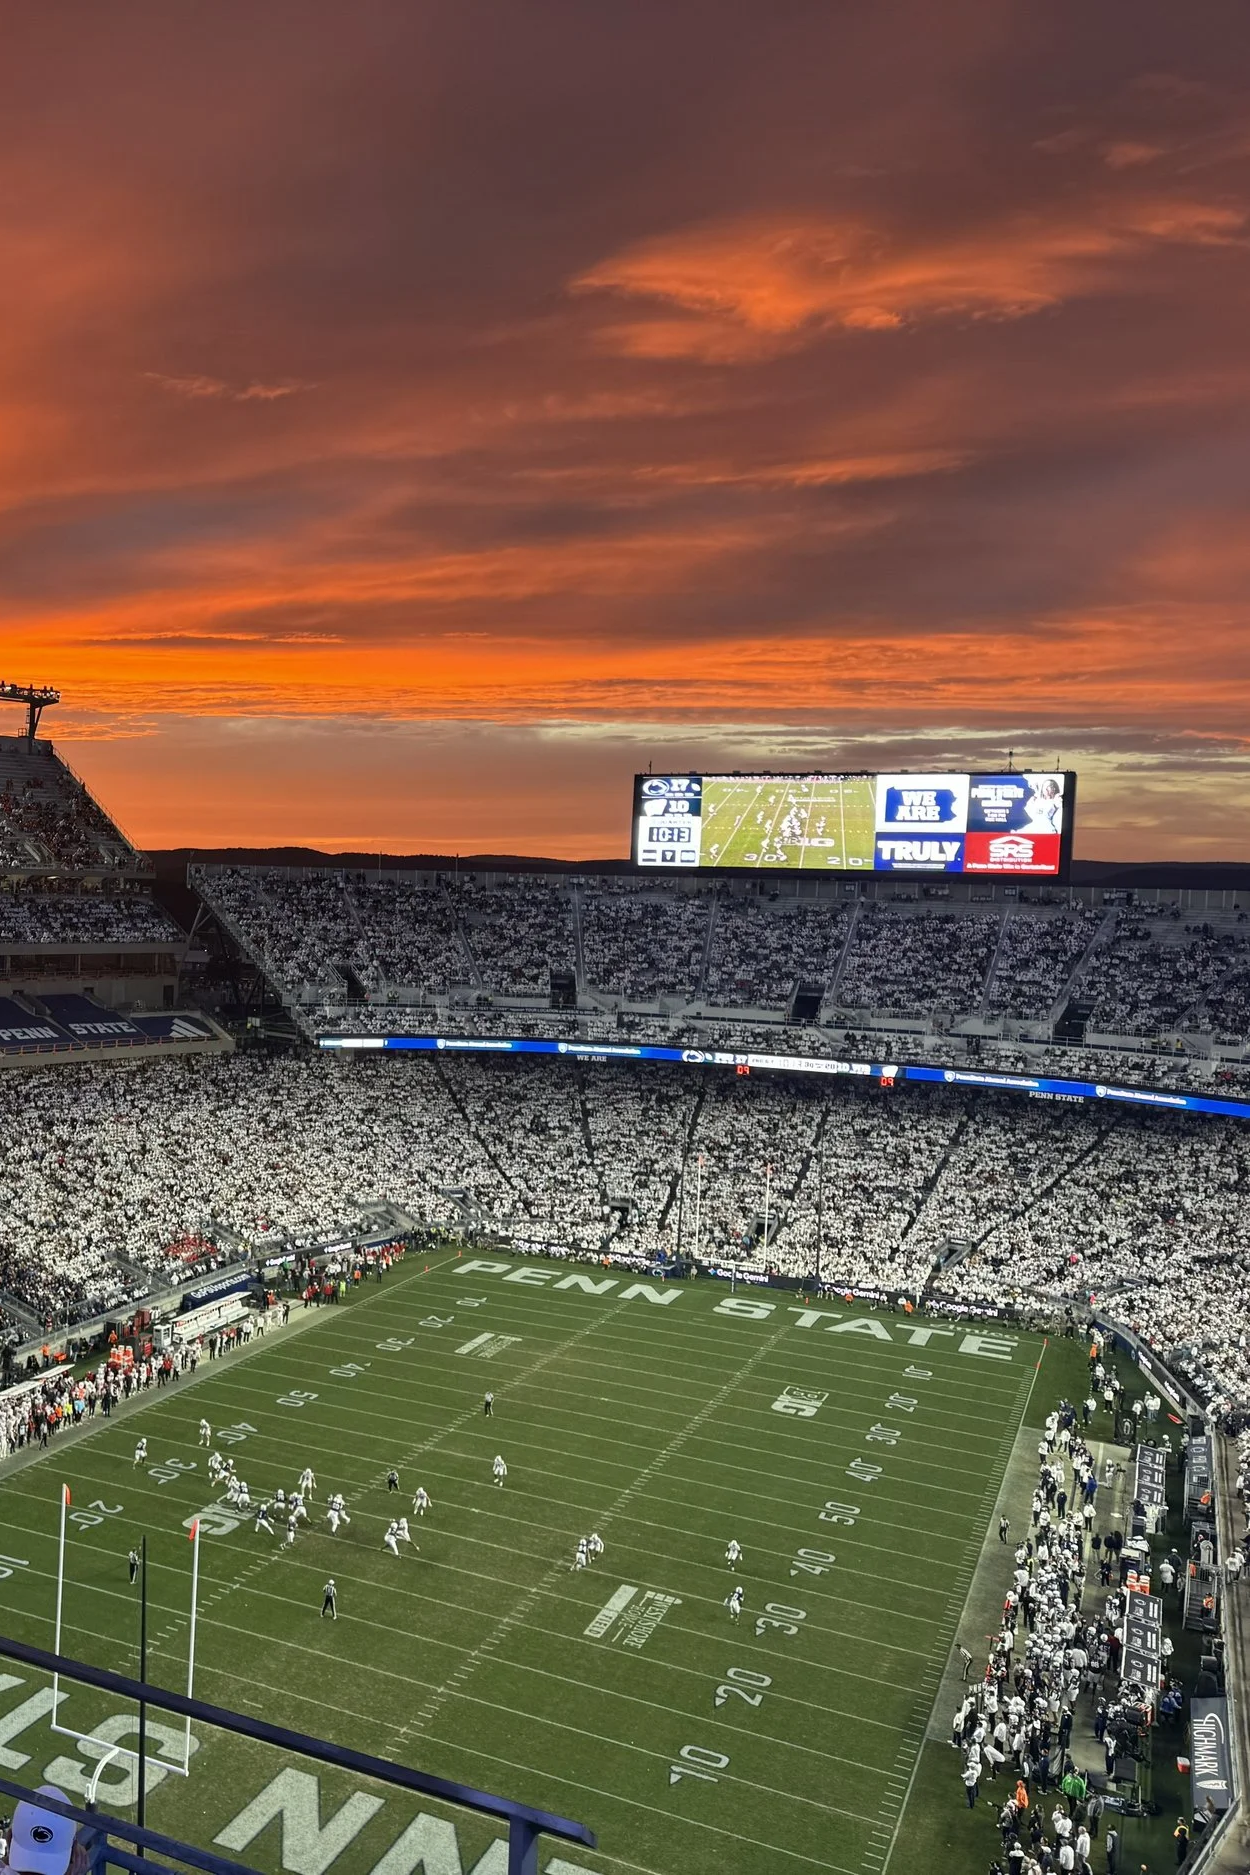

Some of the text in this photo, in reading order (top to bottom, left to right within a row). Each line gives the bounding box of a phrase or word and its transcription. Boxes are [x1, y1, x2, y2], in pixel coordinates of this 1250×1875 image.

[668, 800, 690, 813] 10
[901, 791, 936, 806] WE
[895, 806, 940, 821] ARE
[652, 828, 690, 842] 10:13
[989, 843, 1034, 857] SRS
[67, 1020, 137, 1035] STATE
[1028, 1091, 1085, 1103] PENN STATE
[452, 1259, 1019, 1361] PENN STATE
[418, 1315, 452, 1328] 20
[375, 1337, 412, 1351] 30
[329, 1362, 365, 1378] 40
[276, 1390, 319, 1407] 50
[884, 1395, 918, 1413] 20
[216, 1422, 258, 1441] 40
[865, 1426, 902, 1445] 30
[147, 1458, 198, 1480] 30
[846, 1461, 883, 1483] 40
[68, 1500, 124, 1526] 20
[818, 1501, 861, 1526] 50
[792, 1548, 836, 1575] 40
[588, 1612, 614, 1636] FIELD
[622, 1600, 672, 1650] WEST SHORE
[756, 1602, 807, 1635] 30
[716, 1667, 772, 1707] 20
[1193, 1714, 1221, 1776] HIGHMARK
[670, 1745, 730, 1783] 10
